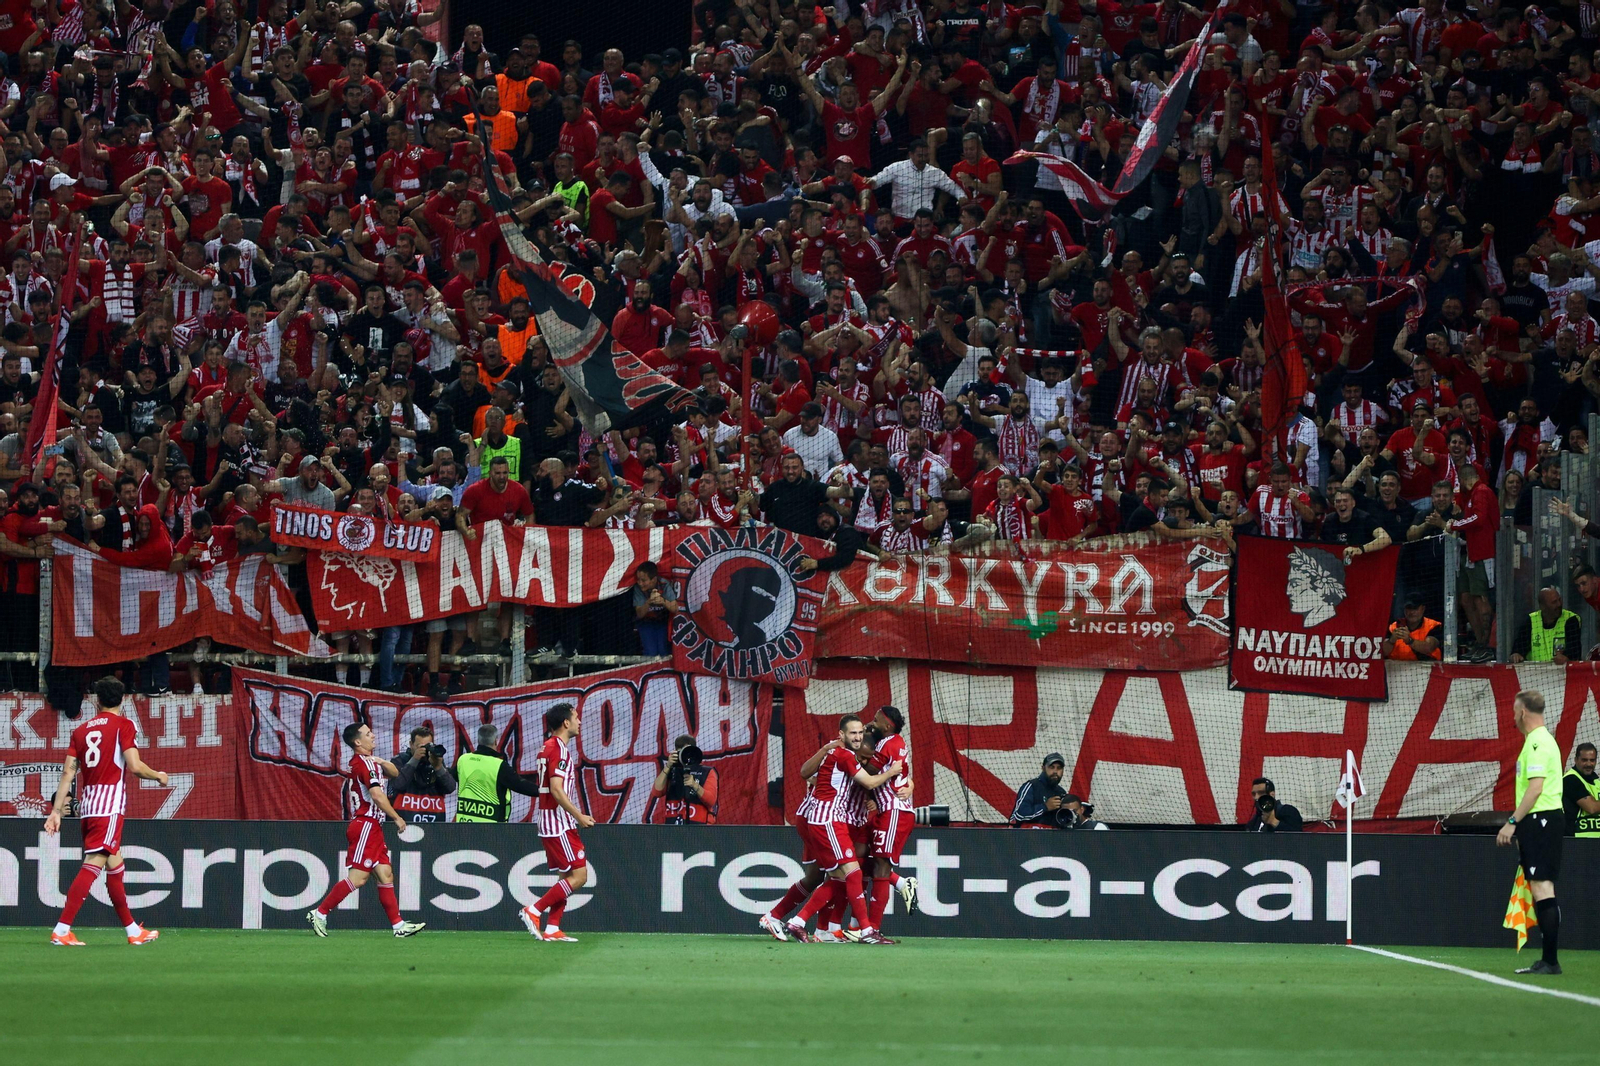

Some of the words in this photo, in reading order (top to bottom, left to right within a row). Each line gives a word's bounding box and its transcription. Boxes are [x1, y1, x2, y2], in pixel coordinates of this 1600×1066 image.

[275, 507, 333, 541] TINOS
[383, 522, 434, 553] CLUB
[801, 602, 817, 620] 95
[1069, 617, 1128, 634] SINCE
[1130, 621, 1175, 638] 1999
[672, 614, 804, 679] ΦΑΛΗΡΟ
[1237, 626, 1383, 660] ΝΑΥΠΑΚΤΟΣ
[1254, 655, 1370, 680] ΟΛΥΜΠΙΑΚΟΣ
[84, 730, 103, 768] 8
[140, 772, 195, 820] 7
[872, 829, 887, 846] 23
[661, 838, 1381, 922] ret-a-car
